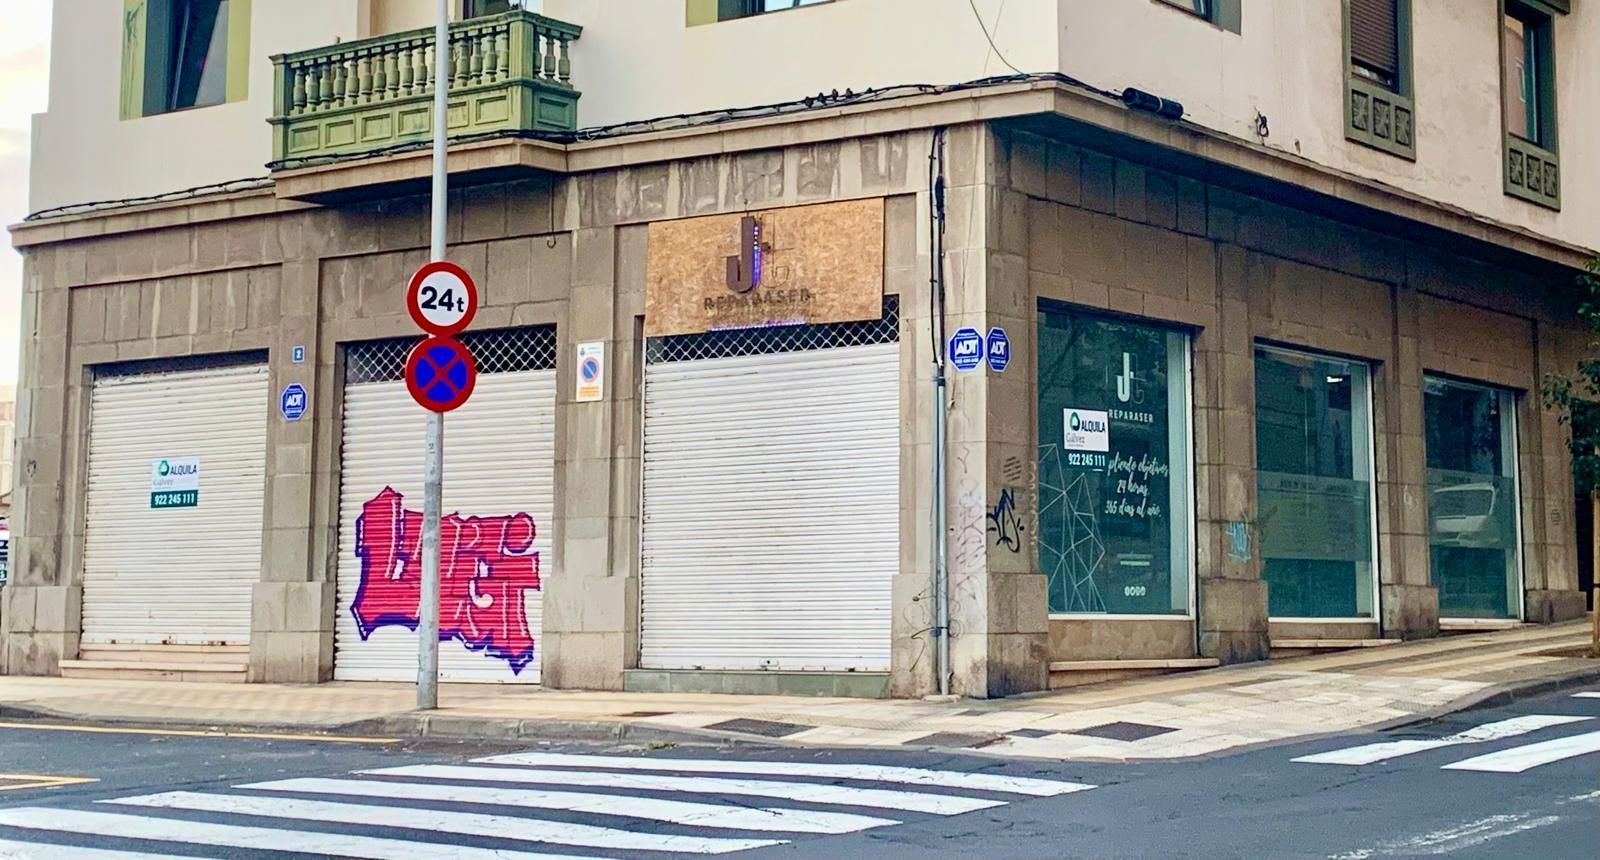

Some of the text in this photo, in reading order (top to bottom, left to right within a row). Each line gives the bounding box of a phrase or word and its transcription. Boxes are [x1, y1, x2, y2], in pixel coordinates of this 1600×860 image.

[956, 339, 978, 355] ADT
[990, 340, 1006, 356] ADT
[286, 393, 303, 407] ADT
[1108, 409, 1154, 423] REPARASER
[1081, 420, 1106, 433] ALQUILA
[1068, 453, 1106, 467] 922 245 111
[1107, 451, 1137, 477] pliendo
[170, 464, 197, 476] ALQUILA
[155, 493, 195, 505] 922 245 111
[1105, 500, 1118, 515] 365
[1136, 497, 1148, 518] al
